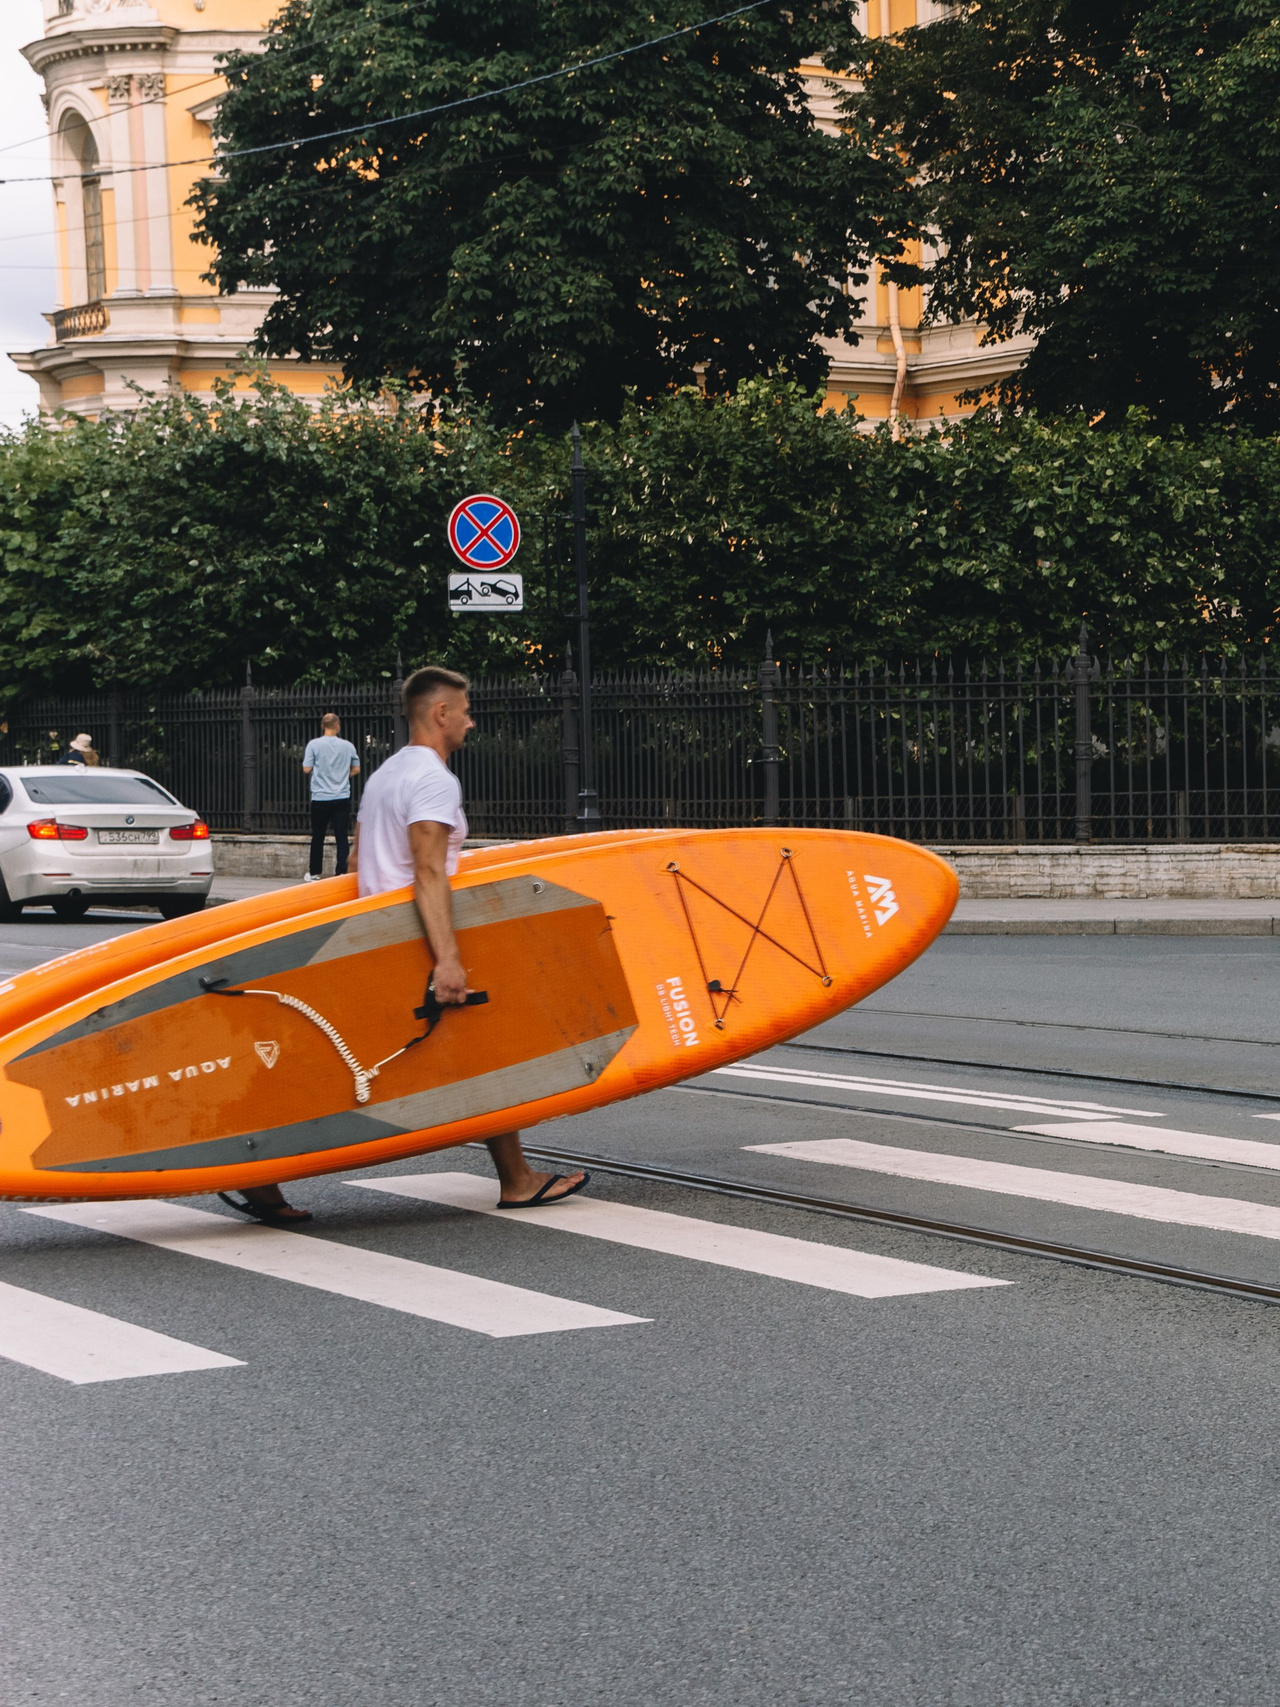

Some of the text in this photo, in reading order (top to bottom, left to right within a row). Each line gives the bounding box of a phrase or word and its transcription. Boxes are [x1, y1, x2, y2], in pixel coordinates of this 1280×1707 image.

[855, 900, 873, 938] MARINA
[665, 976, 701, 1047] FUSION
[65, 1056, 232, 1107] AQUA MARINA
